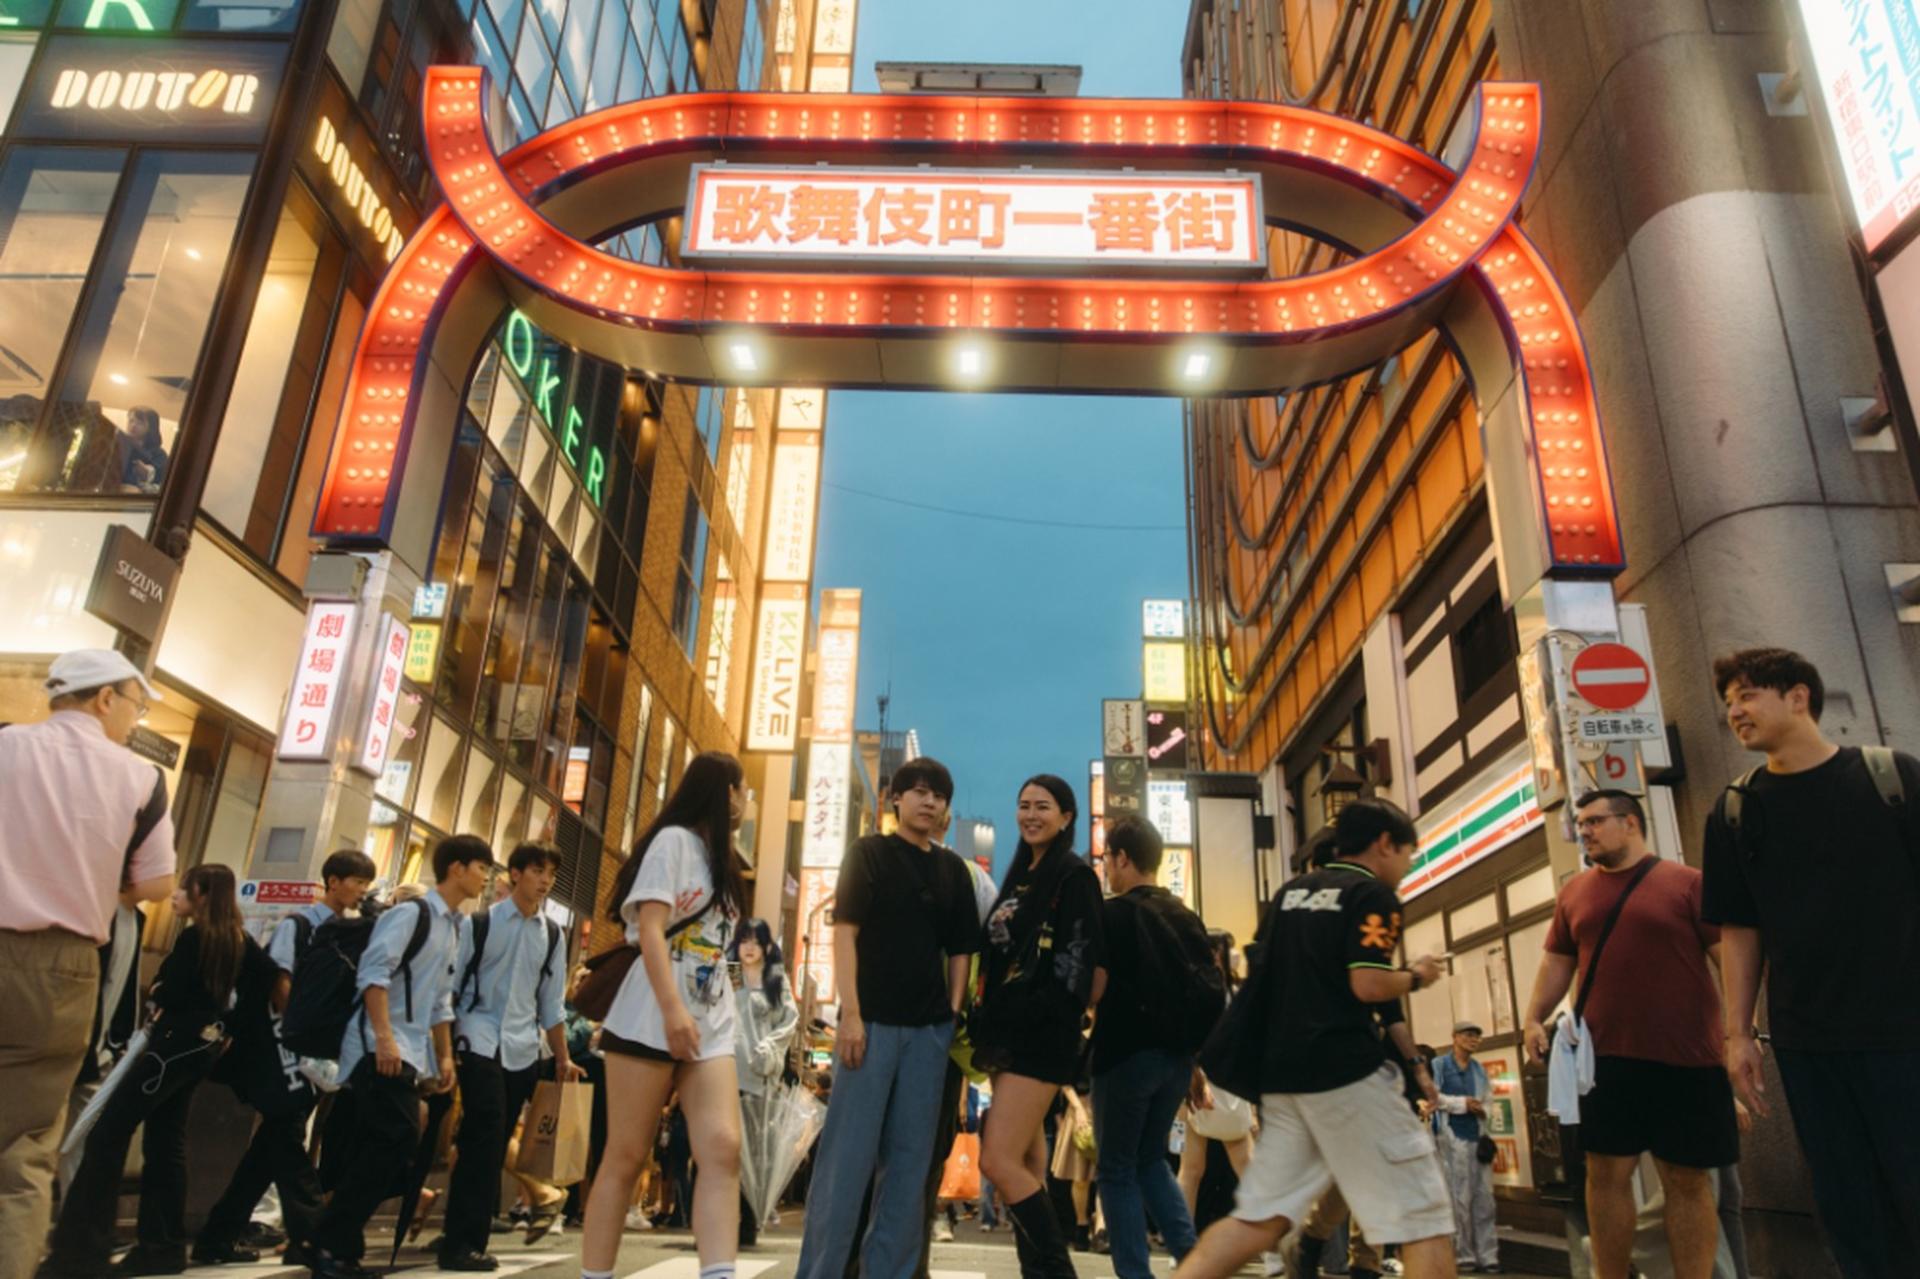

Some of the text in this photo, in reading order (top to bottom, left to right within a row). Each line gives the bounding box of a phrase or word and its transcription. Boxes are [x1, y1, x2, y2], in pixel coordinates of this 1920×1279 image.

[51, 69, 260, 113] DOUTOR
[712, 185, 1235, 252] 歌舞伎町一番街
[115, 560, 163, 603] SUZUYA
[296, 613, 345, 743] 劇場通り
[1583, 717, 1656, 737] 自転車を除く
[538, 1115, 557, 1136] GU
